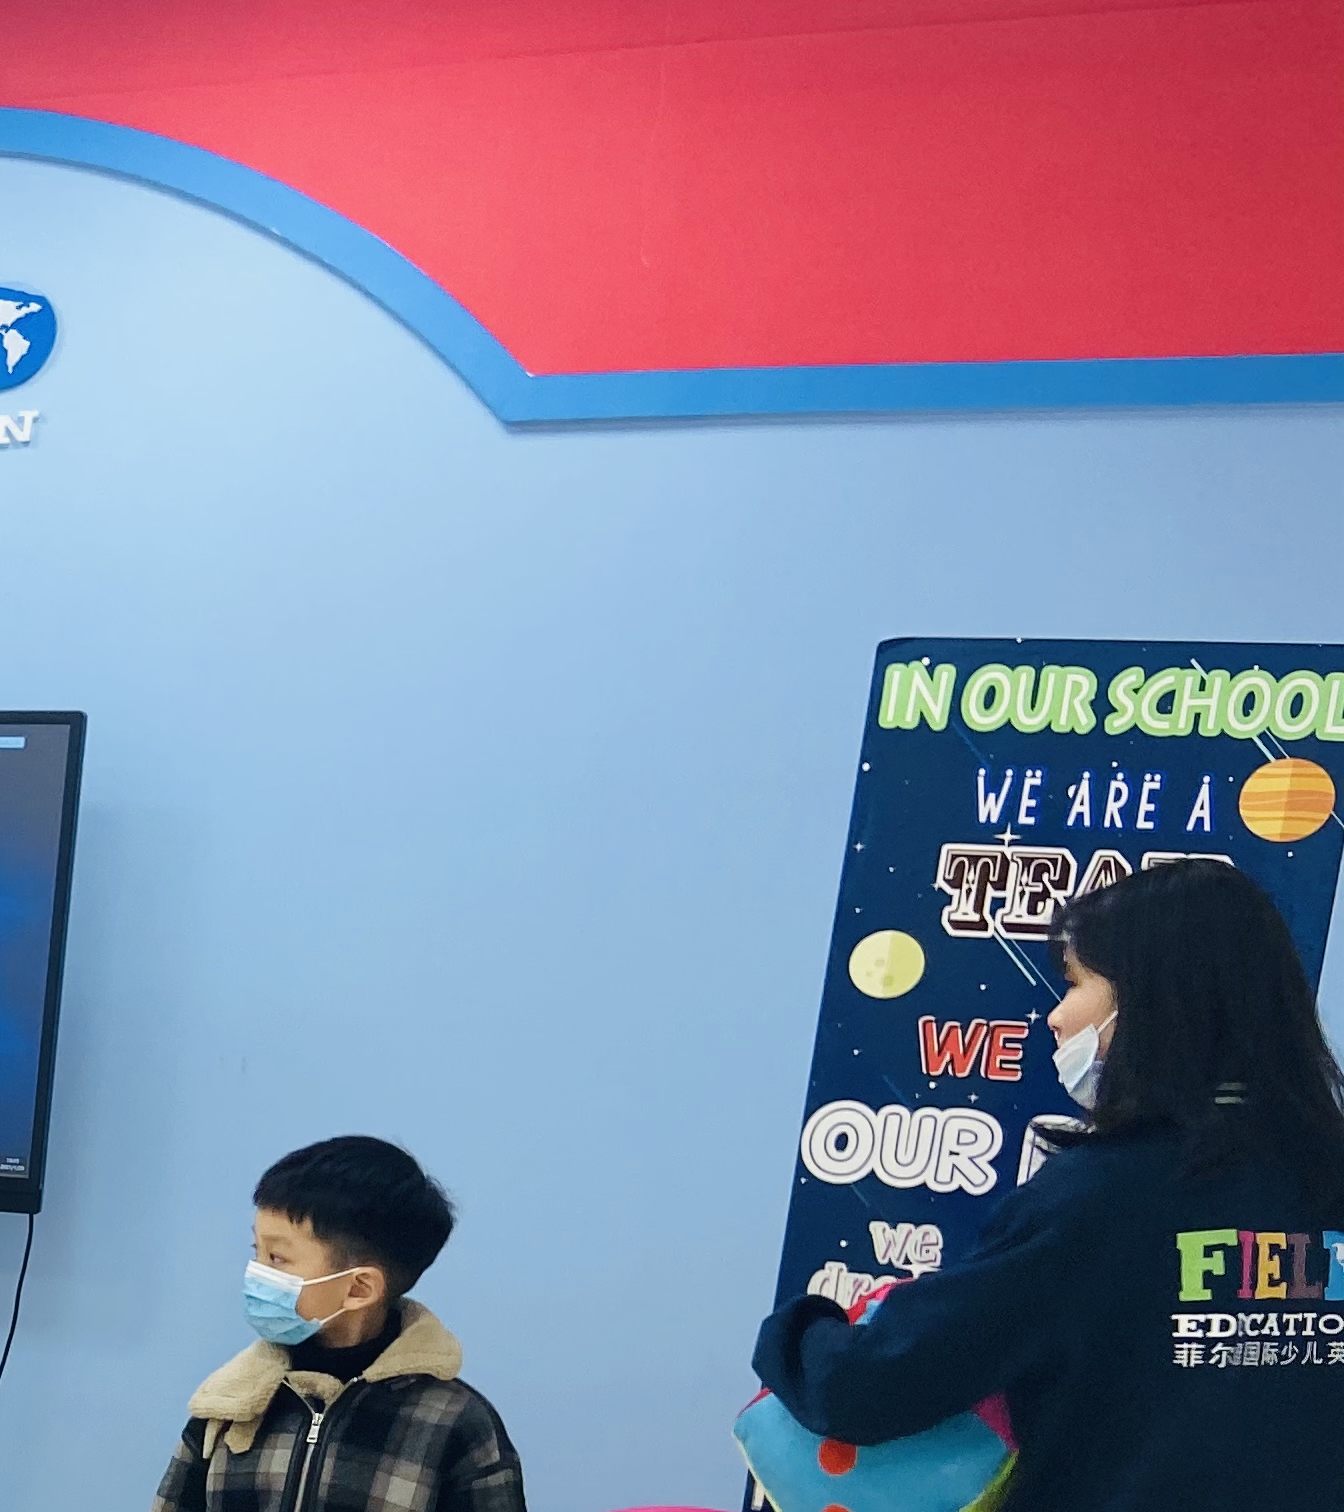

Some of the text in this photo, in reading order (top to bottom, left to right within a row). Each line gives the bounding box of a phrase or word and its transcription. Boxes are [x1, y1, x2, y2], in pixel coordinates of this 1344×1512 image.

[878, 662, 957, 732] IN
[960, 664, 1098, 735] OUR
[975, 768, 1214, 832] WE ARE A
[918, 1015, 1029, 1081] WE
[801, 1100, 1003, 1196] OUR
[869, 1220, 944, 1271] we
